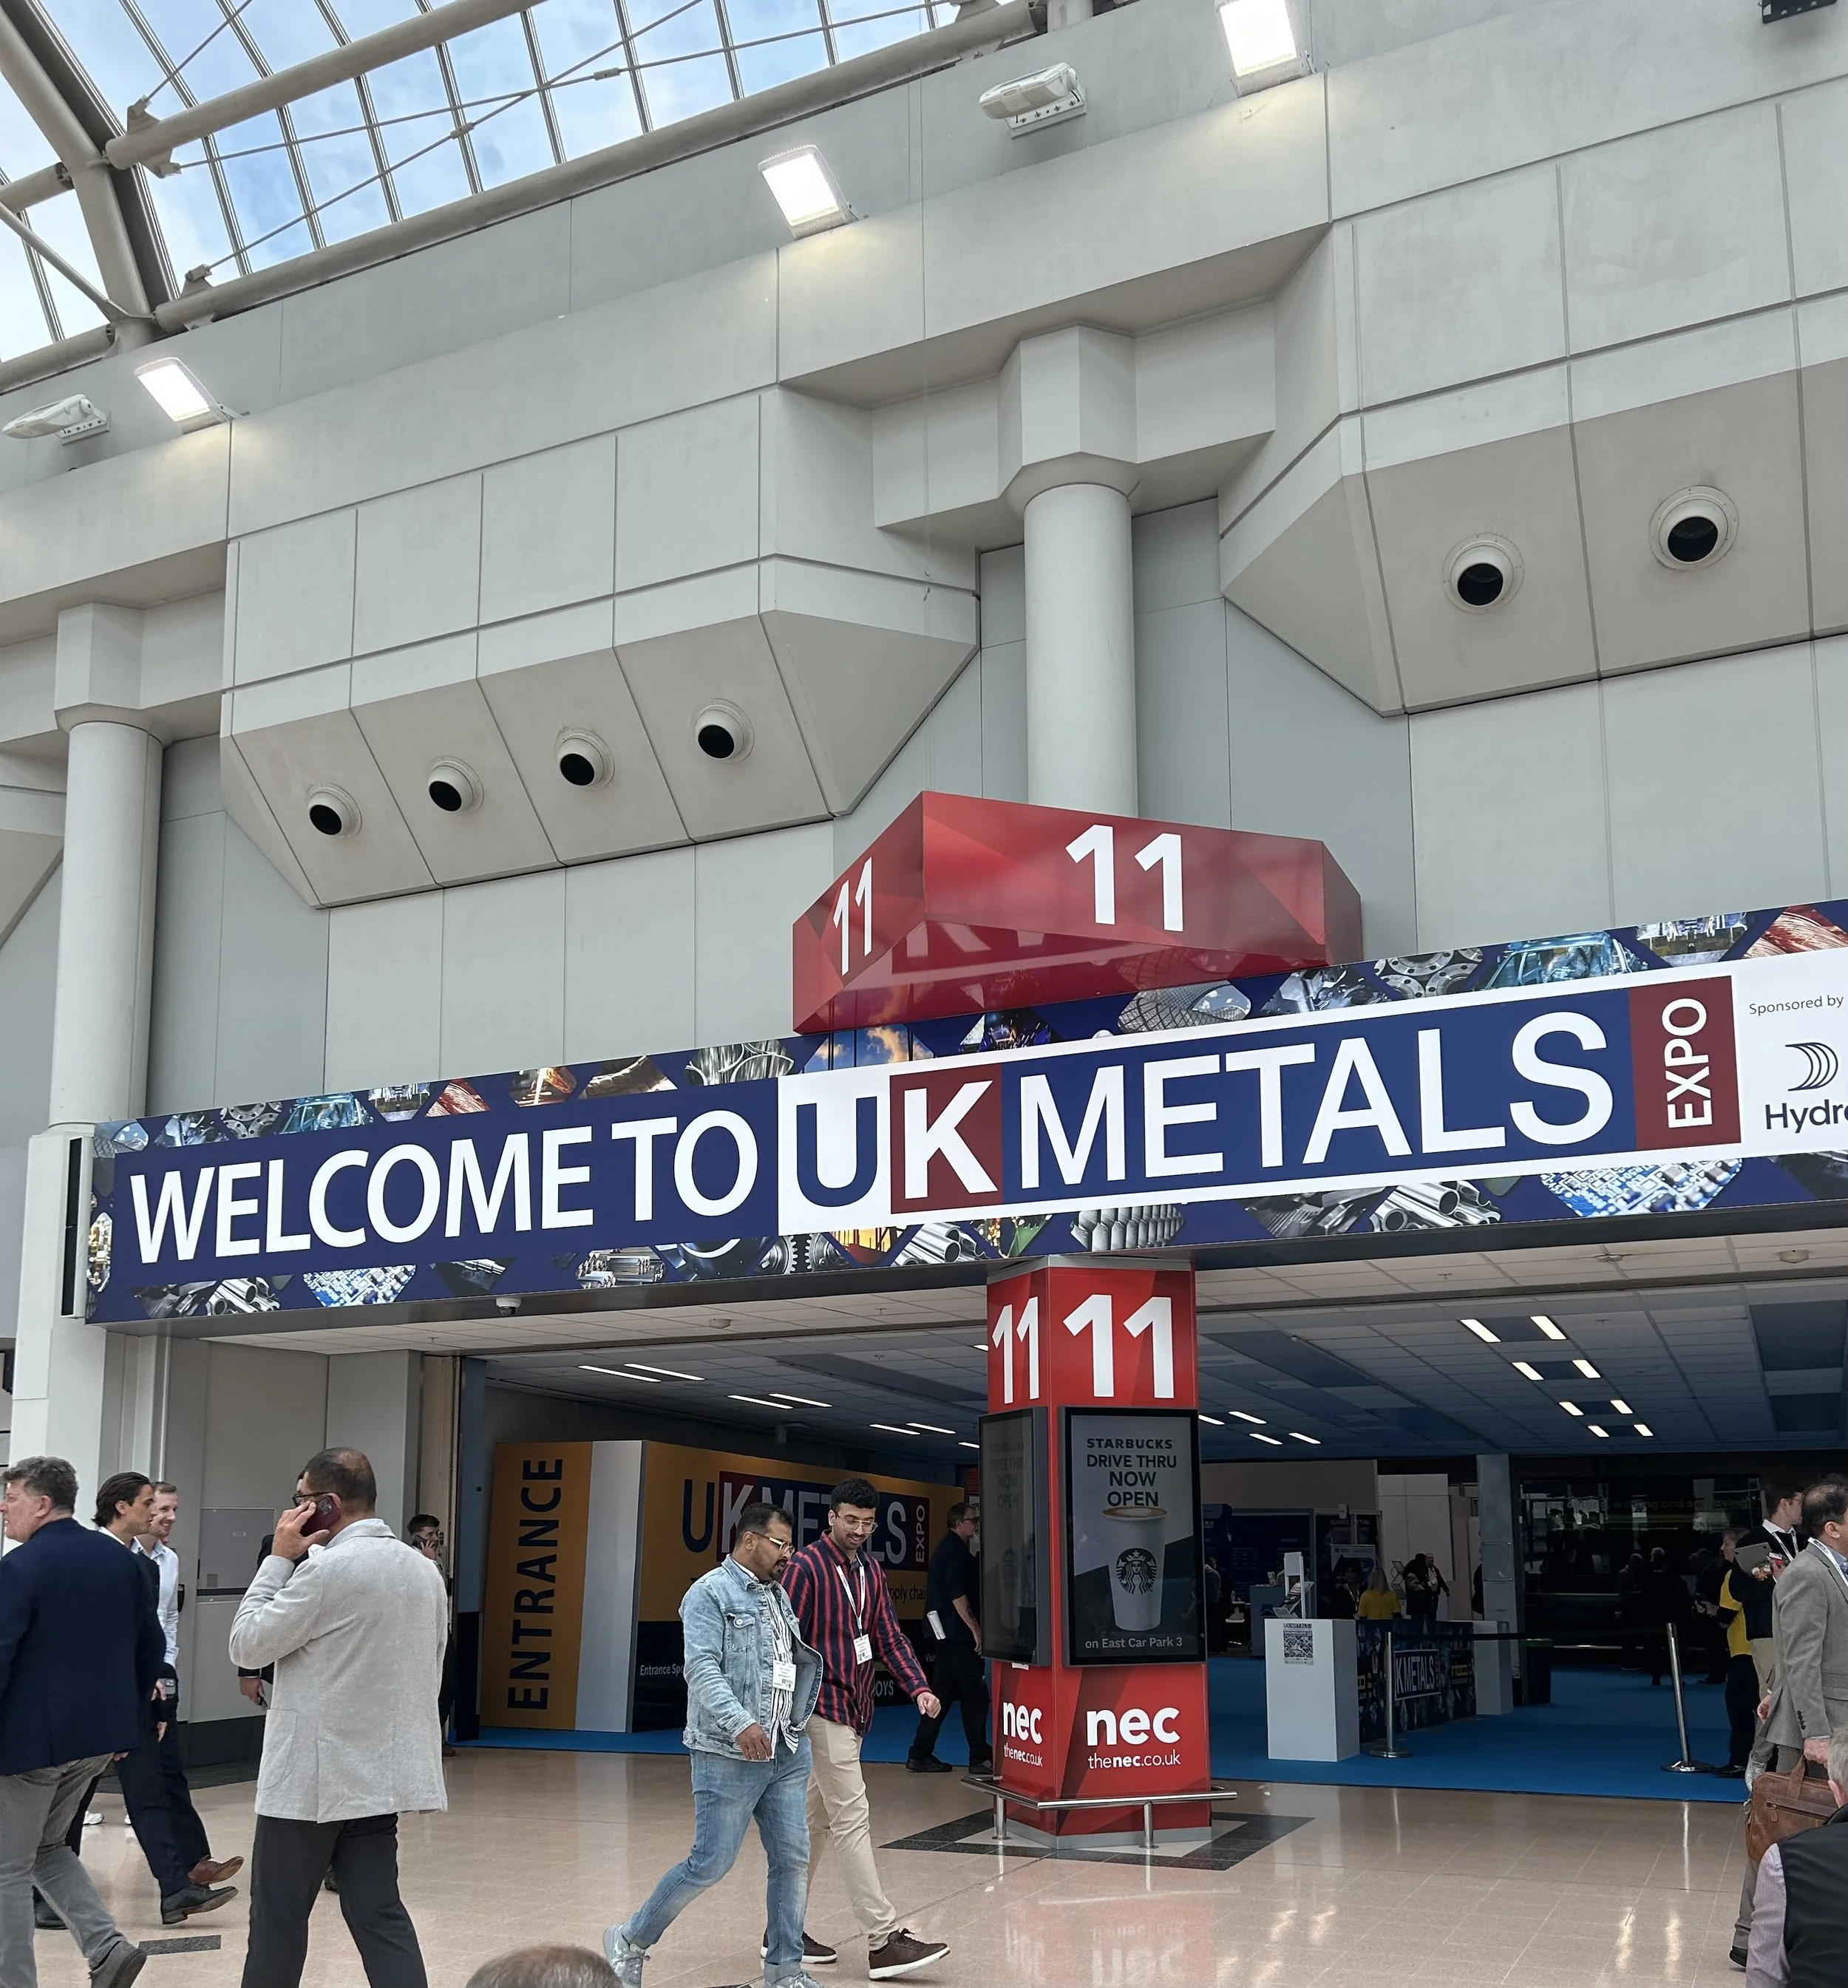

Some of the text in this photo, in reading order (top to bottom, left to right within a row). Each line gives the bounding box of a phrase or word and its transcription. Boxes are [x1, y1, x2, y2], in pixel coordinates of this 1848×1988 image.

[1065, 824, 1184, 933] 11
[832, 856, 874, 976] 11
[1749, 994, 1844, 1017] Sponsored by
[1661, 998, 1713, 1129] EXPO
[1764, 1098, 1848, 1134] Hydr
[129, 1011, 1614, 1264] WELCOME TO UK METALS
[991, 1296, 1040, 1404] 11
[1062, 1294, 1175, 1399] 11
[1086, 1437, 1173, 1449] STARBUCKS
[1086, 1454, 1178, 1468] DRIVE THRU
[1109, 1471, 1157, 1487] NOW
[1107, 1491, 1159, 1508] OPEN
[915, 1504, 925, 1563] EXPO
[507, 1458, 563, 1709] ENTRANCE
[889, 1583, 925, 1604] pply chai
[1084, 1636, 1183, 1649] on East Car Park 3
[639, 1664, 671, 1676] Entrance
[1002, 1701, 1043, 1745] nec
[1086, 1706, 1181, 1746] nec
[1003, 1742, 1043, 1768] thenec.co.uk
[1088, 1749, 1181, 1769] thenec.co.uk
